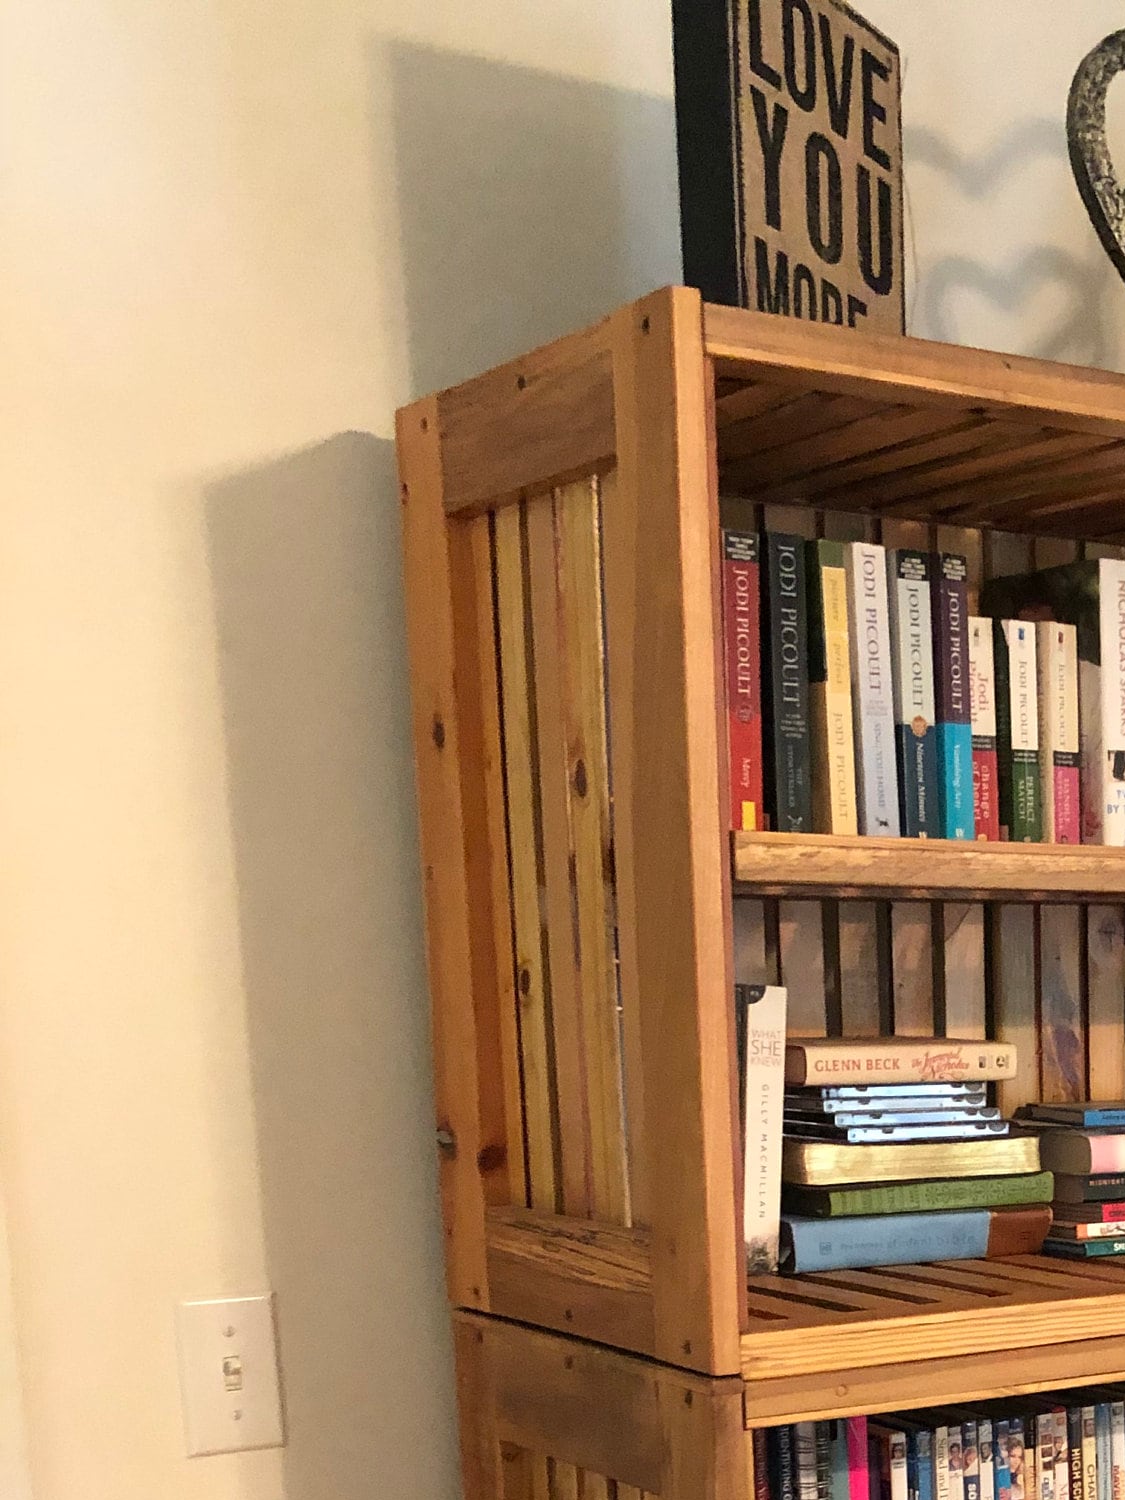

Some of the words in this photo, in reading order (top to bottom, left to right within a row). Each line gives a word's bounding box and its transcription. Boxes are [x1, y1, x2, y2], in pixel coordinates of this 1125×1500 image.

[749, 0, 891, 171] LOVE
[750, 84, 893, 295] YOU
[755, 236, 867, 327] MO
[733, 567, 750, 610] JODI
[778, 546, 797, 597] JODI
[861, 554, 877, 599] JODI
[905, 586, 921, 627] JODI
[947, 589, 961, 630] JODI
[735, 617, 751, 698] PICOULT
[780, 607, 801, 707] PICOULT
[864, 608, 880, 694] PICOULT
[907, 633, 923, 710] PICOULT
[949, 637, 963, 714] PICOULT
[977, 673, 990, 711] Jodi
[1018, 660, 1028, 688] JODI
[1057, 664, 1066, 690] JODI
[832, 713, 845, 746] JODI
[1019, 694, 1029, 746] PICOULT
[1058, 696, 1066, 747] PICOULT
[741, 757, 752, 788] Mercy
[835, 755, 848, 818] PICOULT
[979, 765, 990, 818] change
[917, 784, 927, 823] Minutes
[1017, 780, 1026, 820] MATCH
[1025, 776, 1035, 823] PERFECT
[1106, 805, 1119, 815] BY
[751, 1041, 781, 1057] SHE
[752, 1028, 782, 1039] WHAT
[752, 1055, 782, 1067] KNEW
[814, 1058, 861, 1073] GLENN
[866, 1057, 900, 1070] BECK
[760, 1084, 770, 1124] GILLY
[757, 1133, 768, 1219] MACMILLAN
[779, 1429, 794, 1491] IDENTIFYING
[937, 1438, 948, 1471] Stand
[1071, 1448, 1081, 1479] HIGH
[939, 1475, 949, 1492] and
